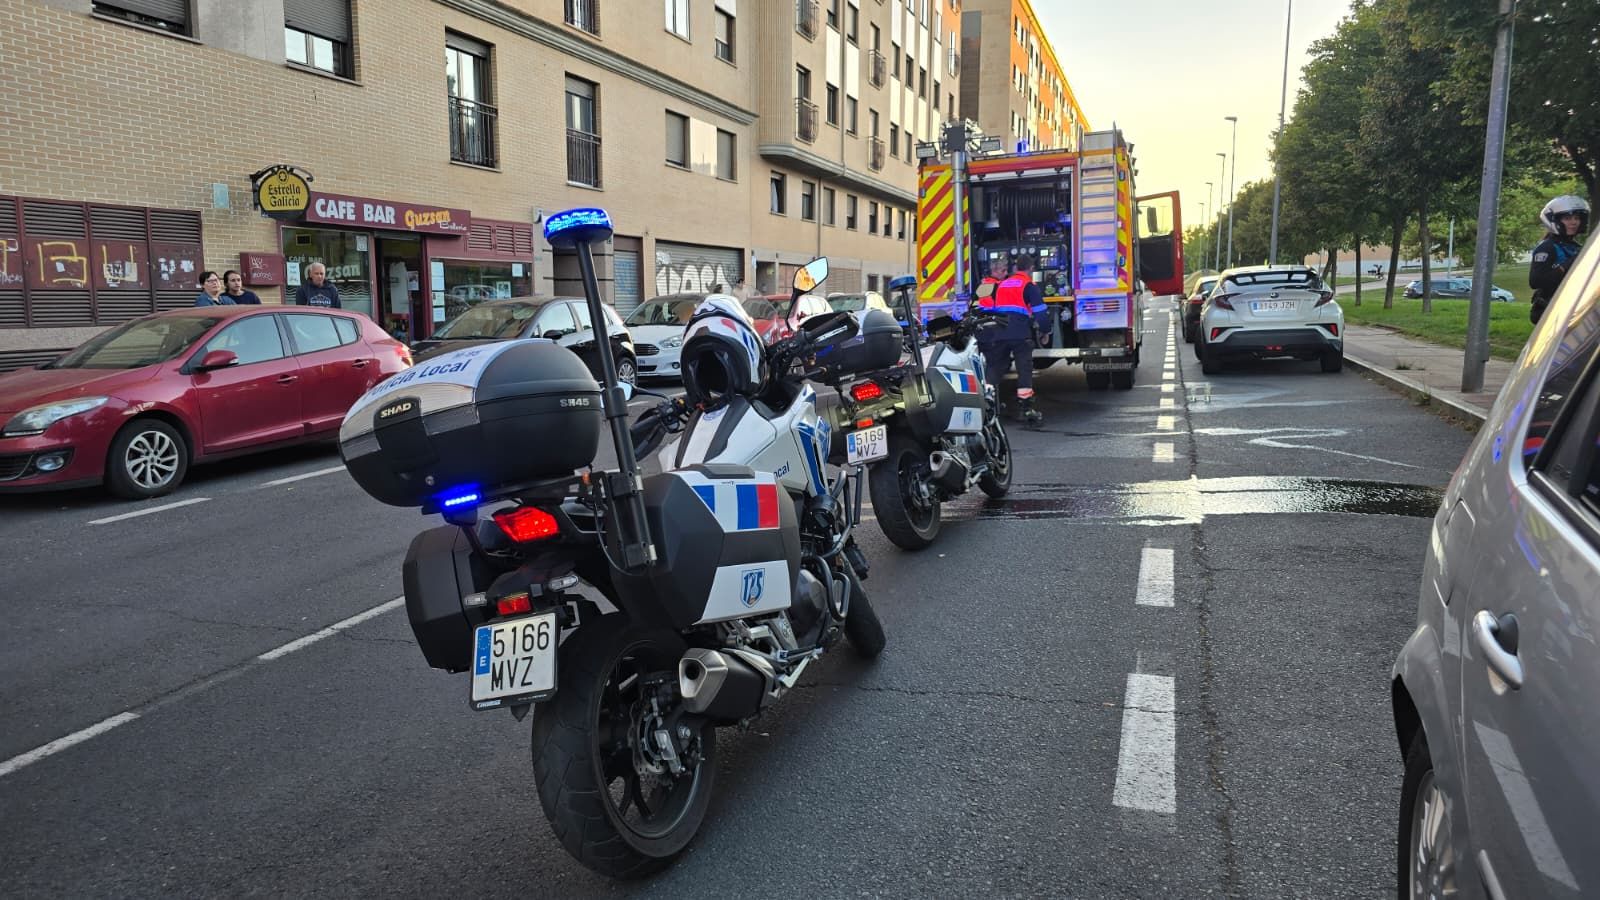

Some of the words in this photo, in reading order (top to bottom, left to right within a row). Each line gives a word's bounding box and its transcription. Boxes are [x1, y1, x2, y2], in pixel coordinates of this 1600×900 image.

[268, 184, 301, 195] Estrella
[270, 196, 300, 207] Galicia
[315, 198, 356, 221] CAFE
[363, 203, 396, 224] BAR
[404, 209, 451, 231] Guzsan
[419, 359, 472, 378] Local
[380, 402, 412, 418] SHAD
[559, 398, 590, 408] SH45
[856, 428, 884, 446] 5169
[857, 442, 877, 458] MVZ
[492, 621, 550, 658] 5166
[479, 655, 487, 667] E
[491, 656, 534, 692] MVZ
